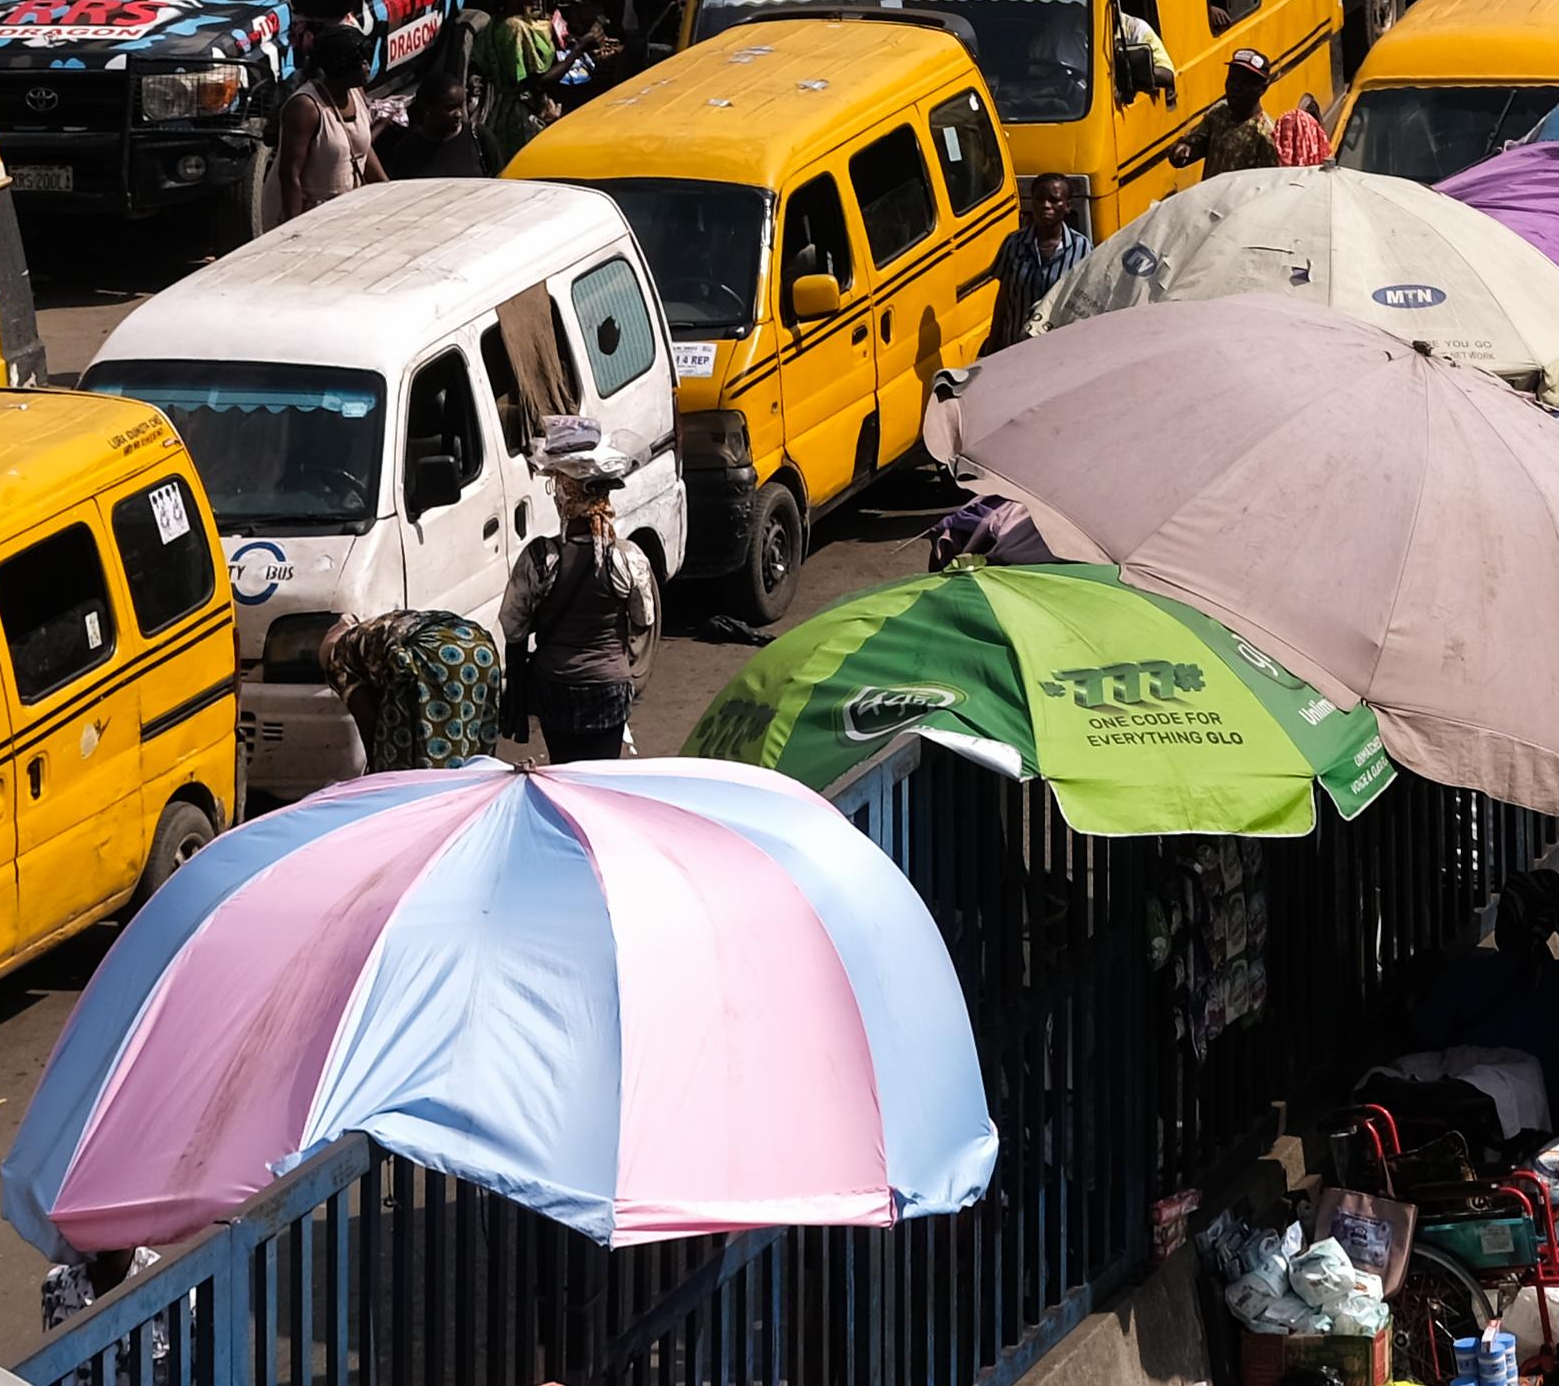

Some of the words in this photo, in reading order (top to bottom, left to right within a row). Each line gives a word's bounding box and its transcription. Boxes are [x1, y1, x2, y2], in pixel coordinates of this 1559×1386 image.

[390, 16, 441, 61] DRAGON
[1386, 290, 1432, 304] MTN
[1444, 339, 1469, 348] YOU
[1474, 340, 1491, 348] GO
[691, 355, 709, 365] REP
[265, 566, 294, 581] BUS
[1089, 717, 1130, 730] ONE
[1131, 715, 1184, 727] CODE
[1185, 712, 1224, 725] FOR
[1087, 733, 1203, 747] EVERYTHING
[1205, 732, 1244, 745] GLO
